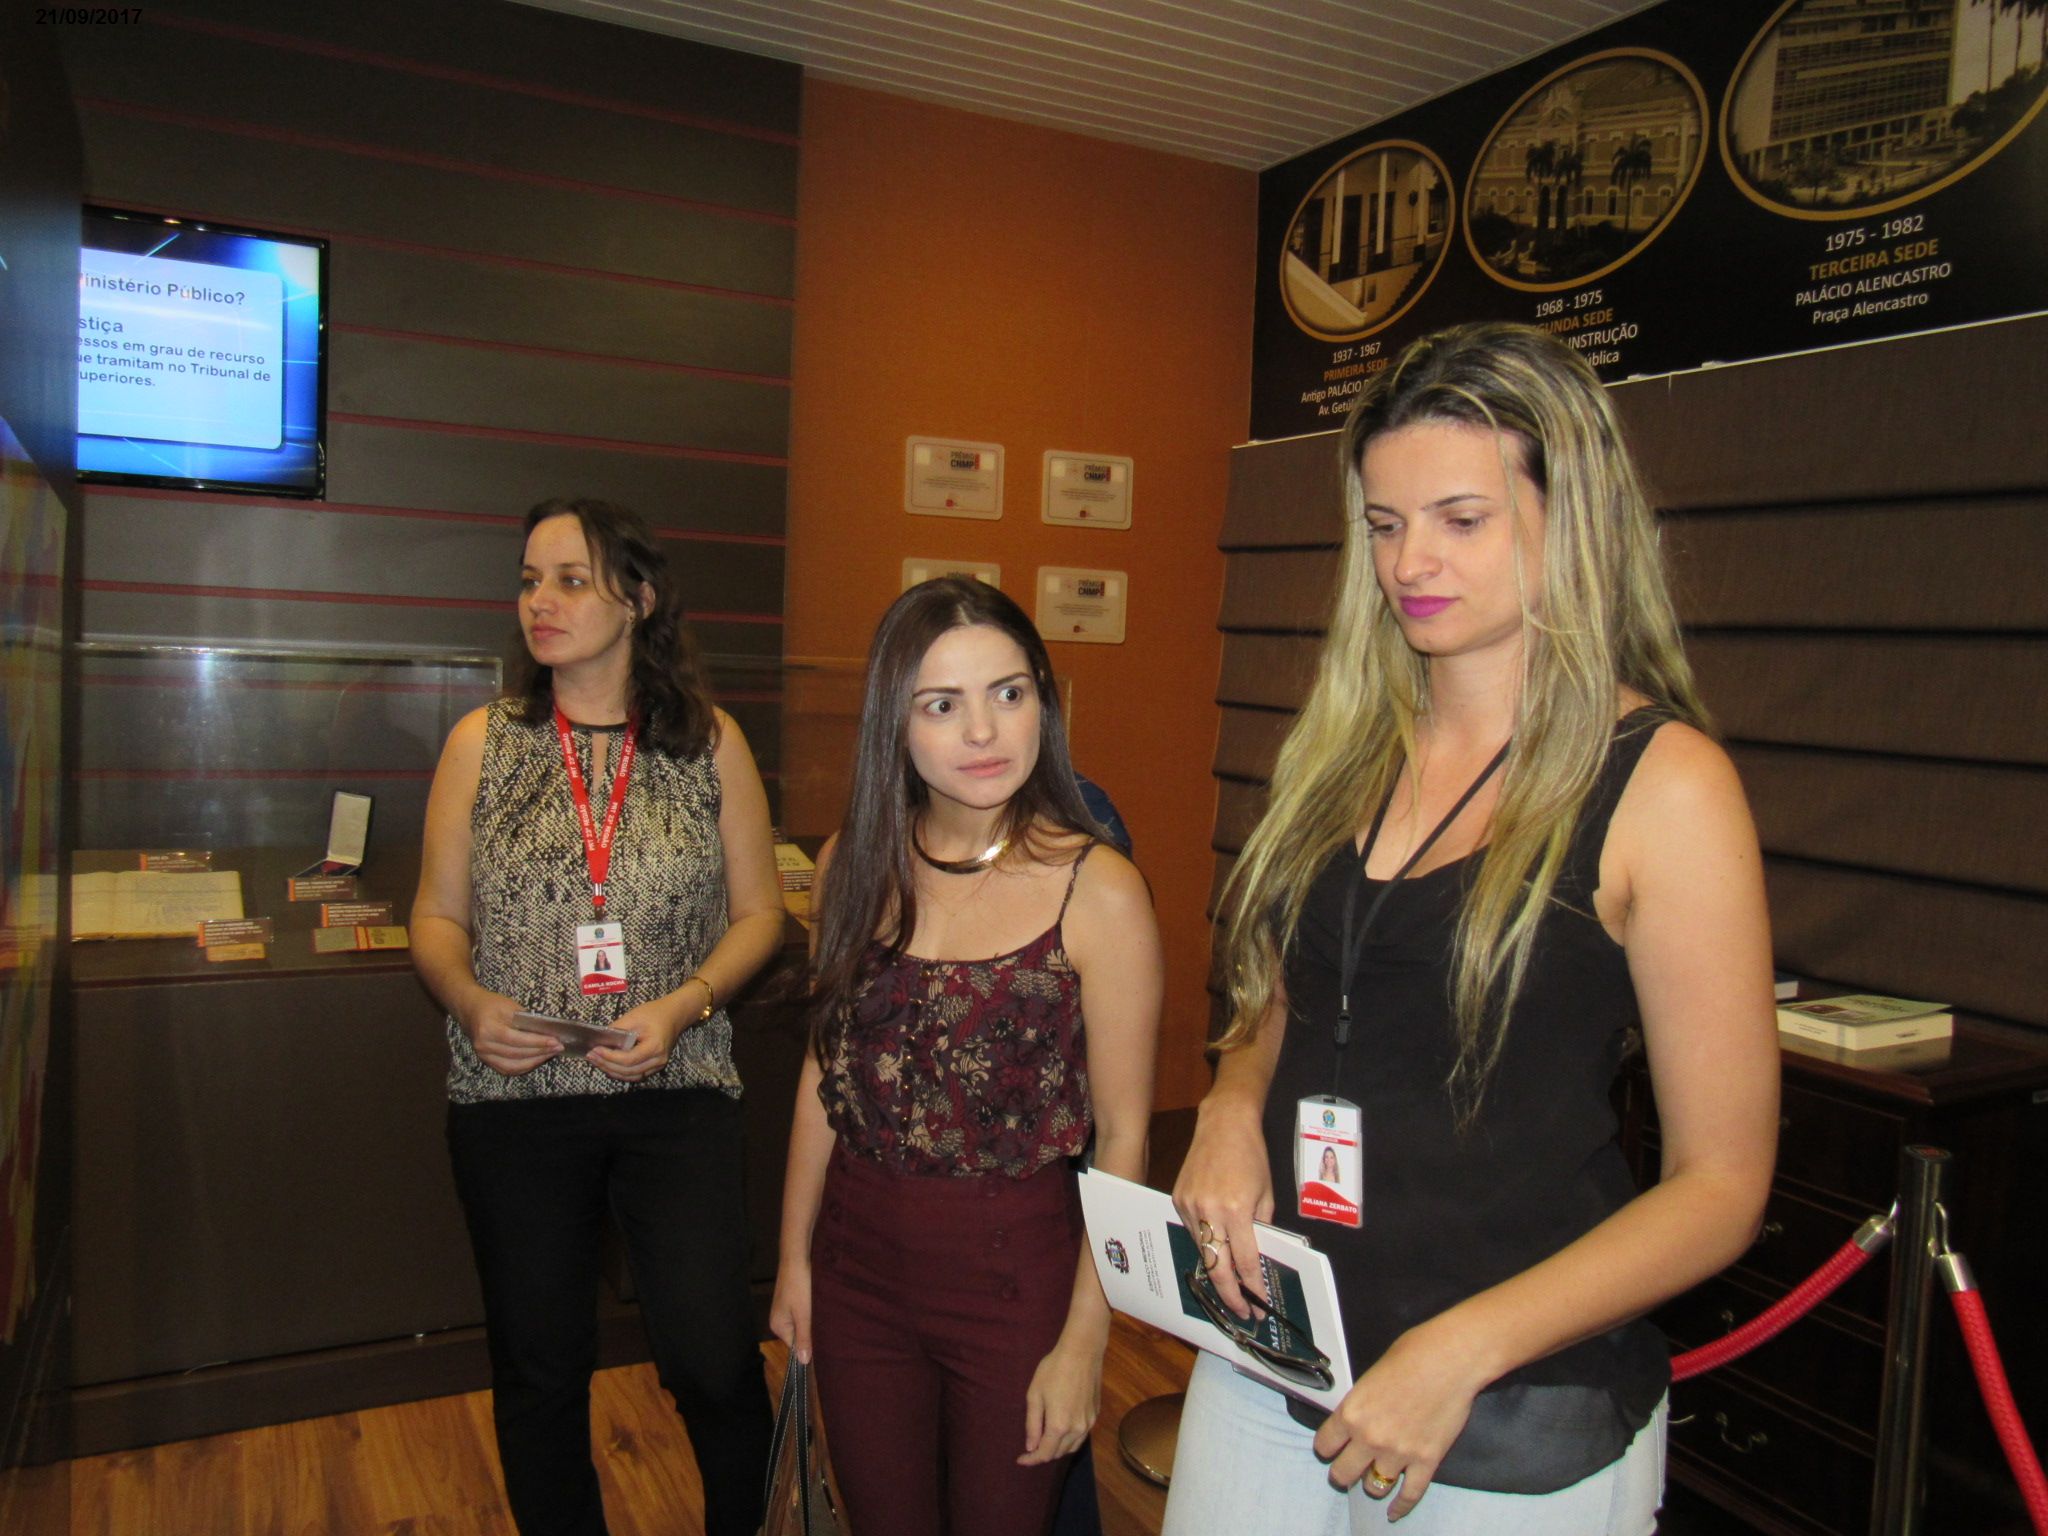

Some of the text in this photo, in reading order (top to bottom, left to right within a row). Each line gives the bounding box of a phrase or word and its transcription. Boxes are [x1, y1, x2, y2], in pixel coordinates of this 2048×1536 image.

[1825, 228, 1865, 252] 1975
[1881, 214, 1924, 239] 1982
[1809, 238, 1939, 281] TERCEIRA SEDE
[80, 273, 245, 305] inistério Público?
[1795, 262, 1952, 306] PALÁCIO ALENCASTRO
[1536, 298, 1563, 318] 1968
[1574, 289, 1603, 309] 1975
[1812, 293, 1929, 325] Praça Alencastro
[1532, 307, 1614, 336] GUNDA SEDE
[1568, 322, 1638, 352] INSTRUÇÃO
[97, 353, 164, 371] tramitam
[168, 363, 186, 373] no
[191, 363, 249, 380] Tribunal
[253, 369, 271, 382] de
[123, 342, 145, 352] em
[150, 344, 183, 356] grau
[187, 346, 205, 359] de
[210, 350, 265, 365] recurso
[1332, 349, 1353, 364] 1937
[1360, 342, 1381, 358] 1967
[1323, 363, 1365, 382] PRIMEIRA
[1300, 389, 1326, 403] Antigo
[1327, 380, 1362, 398] PALÁCIO
[1302, 1197, 1328, 1209] JULIANA
[1329, 1201, 1357, 1213] ZERBATO
